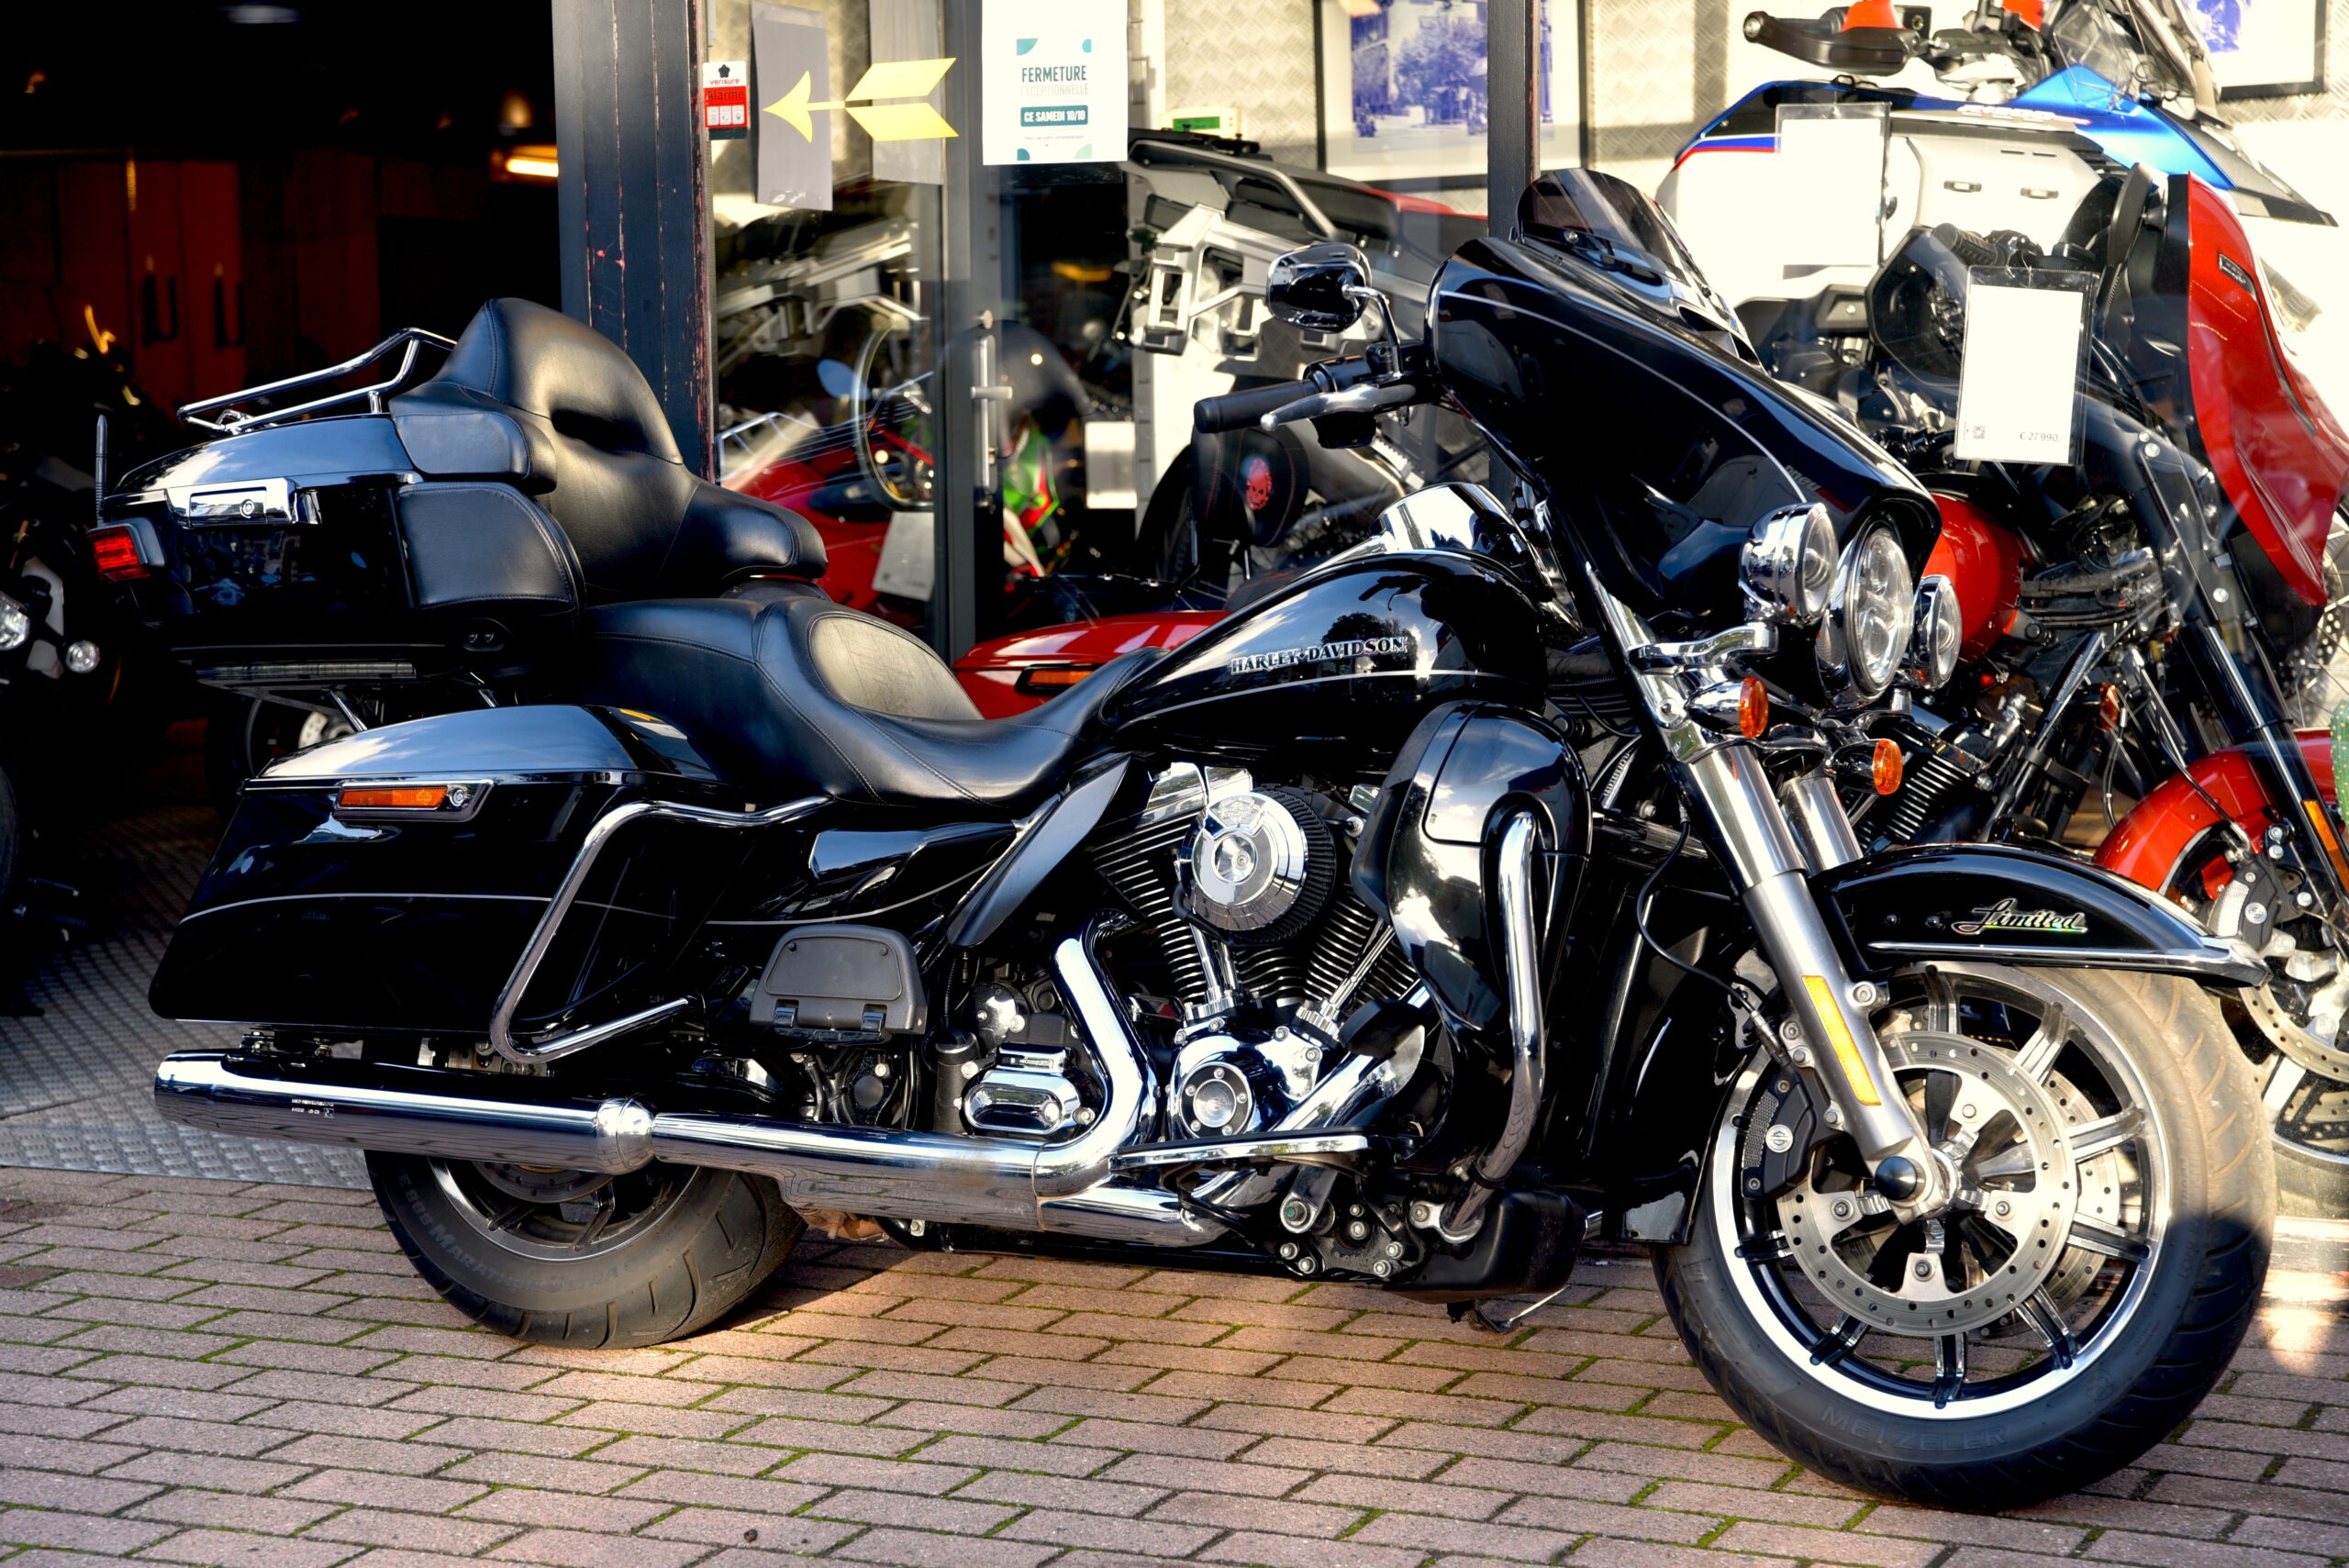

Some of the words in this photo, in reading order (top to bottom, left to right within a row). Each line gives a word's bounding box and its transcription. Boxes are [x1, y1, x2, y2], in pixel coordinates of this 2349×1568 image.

[1021, 65, 1087, 83] FERMETURE
[707, 89, 744, 100] Alarme
[1020, 83, 1089, 97] EXCEPTIONNELLE
[1024, 111, 1034, 122] CE
[1035, 110, 1064, 122] SAMEDI
[1066, 109, 1085, 121] 10/10
[1951, 897, 2088, 936] Limited
[1820, 1406, 2009, 1452] METZELER
